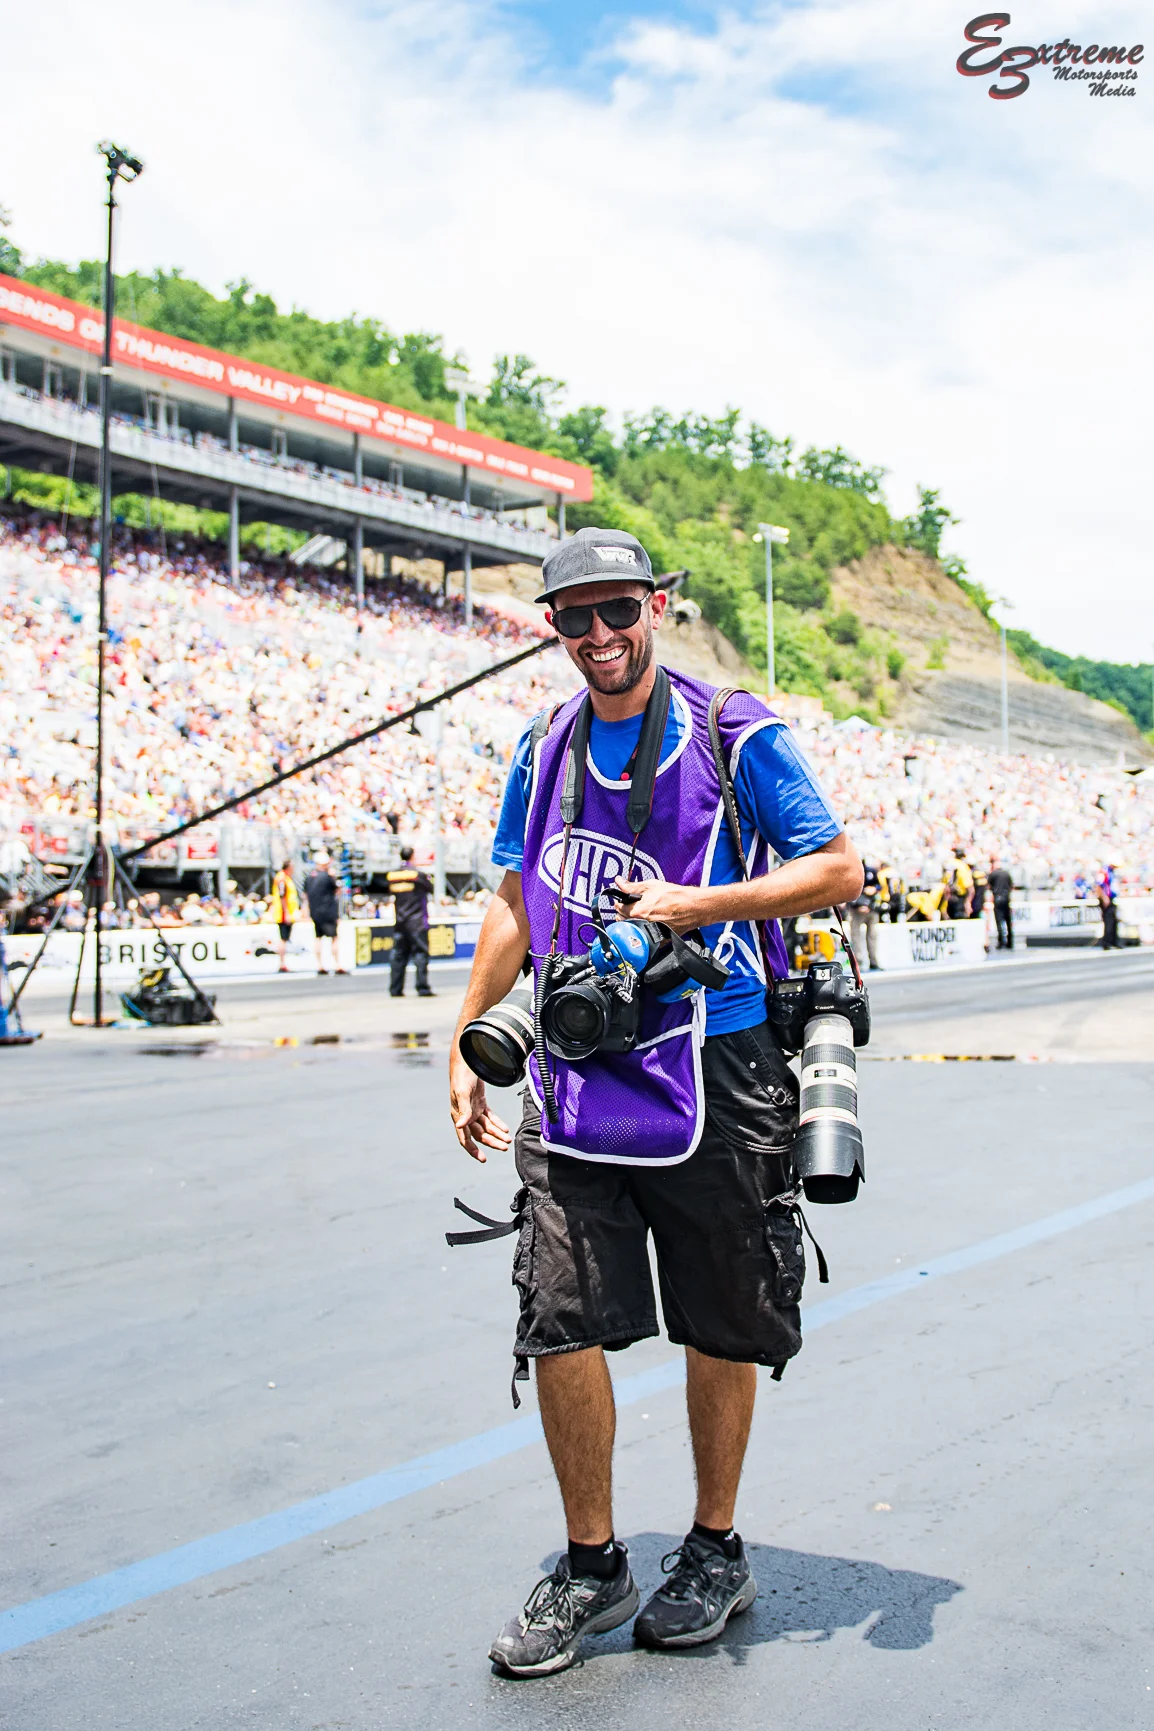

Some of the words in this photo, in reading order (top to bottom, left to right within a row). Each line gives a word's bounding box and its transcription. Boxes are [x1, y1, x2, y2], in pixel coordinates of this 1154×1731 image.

[115, 330, 224, 381] THUNDER
[227, 365, 301, 405] VALLEY
[100, 941, 227, 965] BRISTOL
